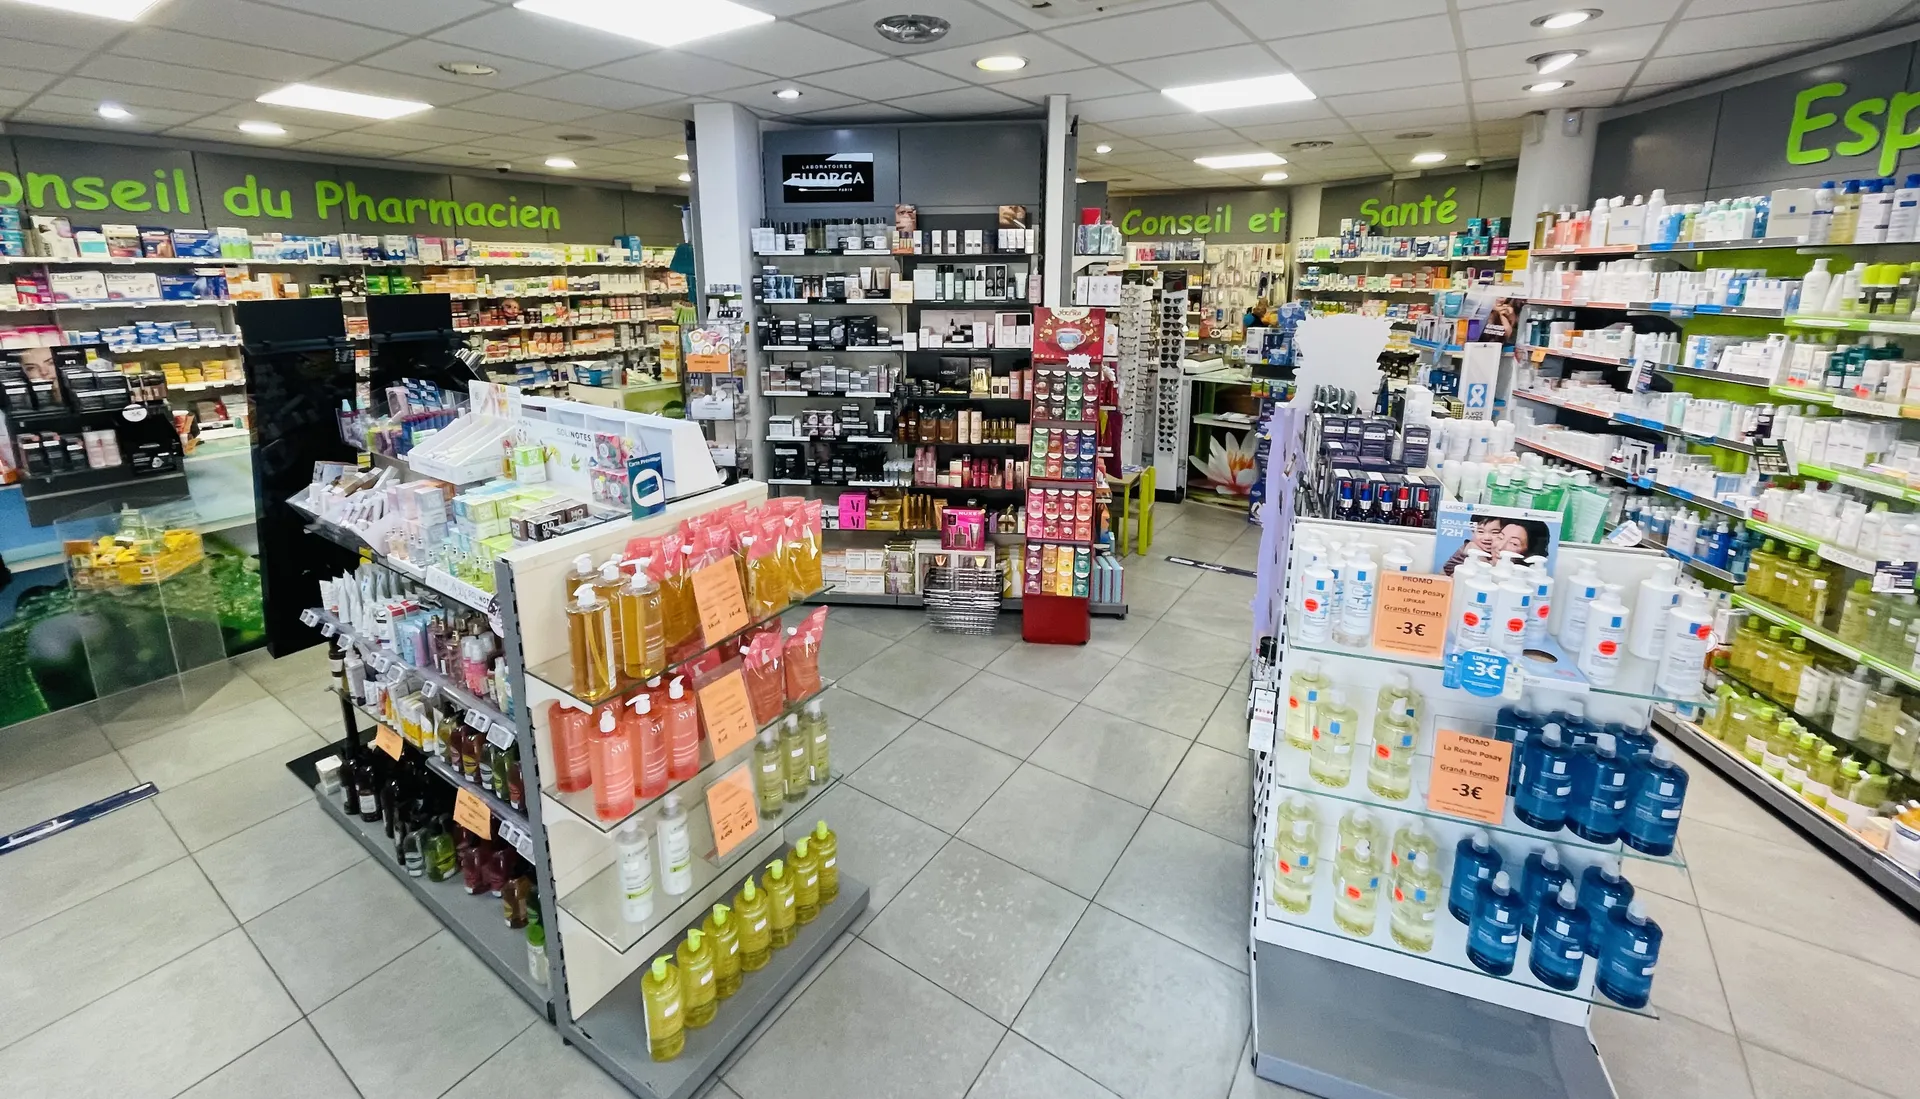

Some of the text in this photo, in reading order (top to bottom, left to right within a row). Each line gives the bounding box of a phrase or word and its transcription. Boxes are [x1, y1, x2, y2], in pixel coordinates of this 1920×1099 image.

[223, 174, 293, 219] du
[315, 180, 561, 230] Pharmacien
[1360, 187, 1457, 227] Santé
[1121, 204, 1286, 235] Conseil et
[1441, 528, 1464, 538] 72H
[1402, 575, 1433, 585] PROMO
[1397, 586, 1421, 595] Roche
[1422, 588, 1446, 599] Posay
[1403, 597, 1426, 605] LIPIKAR
[1384, 604, 1443, 618] Grands formats
[1396, 621, 1426, 637] -3€
[1472, 655, 1500, 665] LIPIKAR
[1467, 661, 1502, 680] -3€
[1458, 735, 1490, 747] PROMO
[1454, 746, 1478, 756] Roche
[1479, 751, 1503, 763] Posay
[1440, 764, 1500, 782] Grands formats
[1452, 783, 1484, 800] -3€
